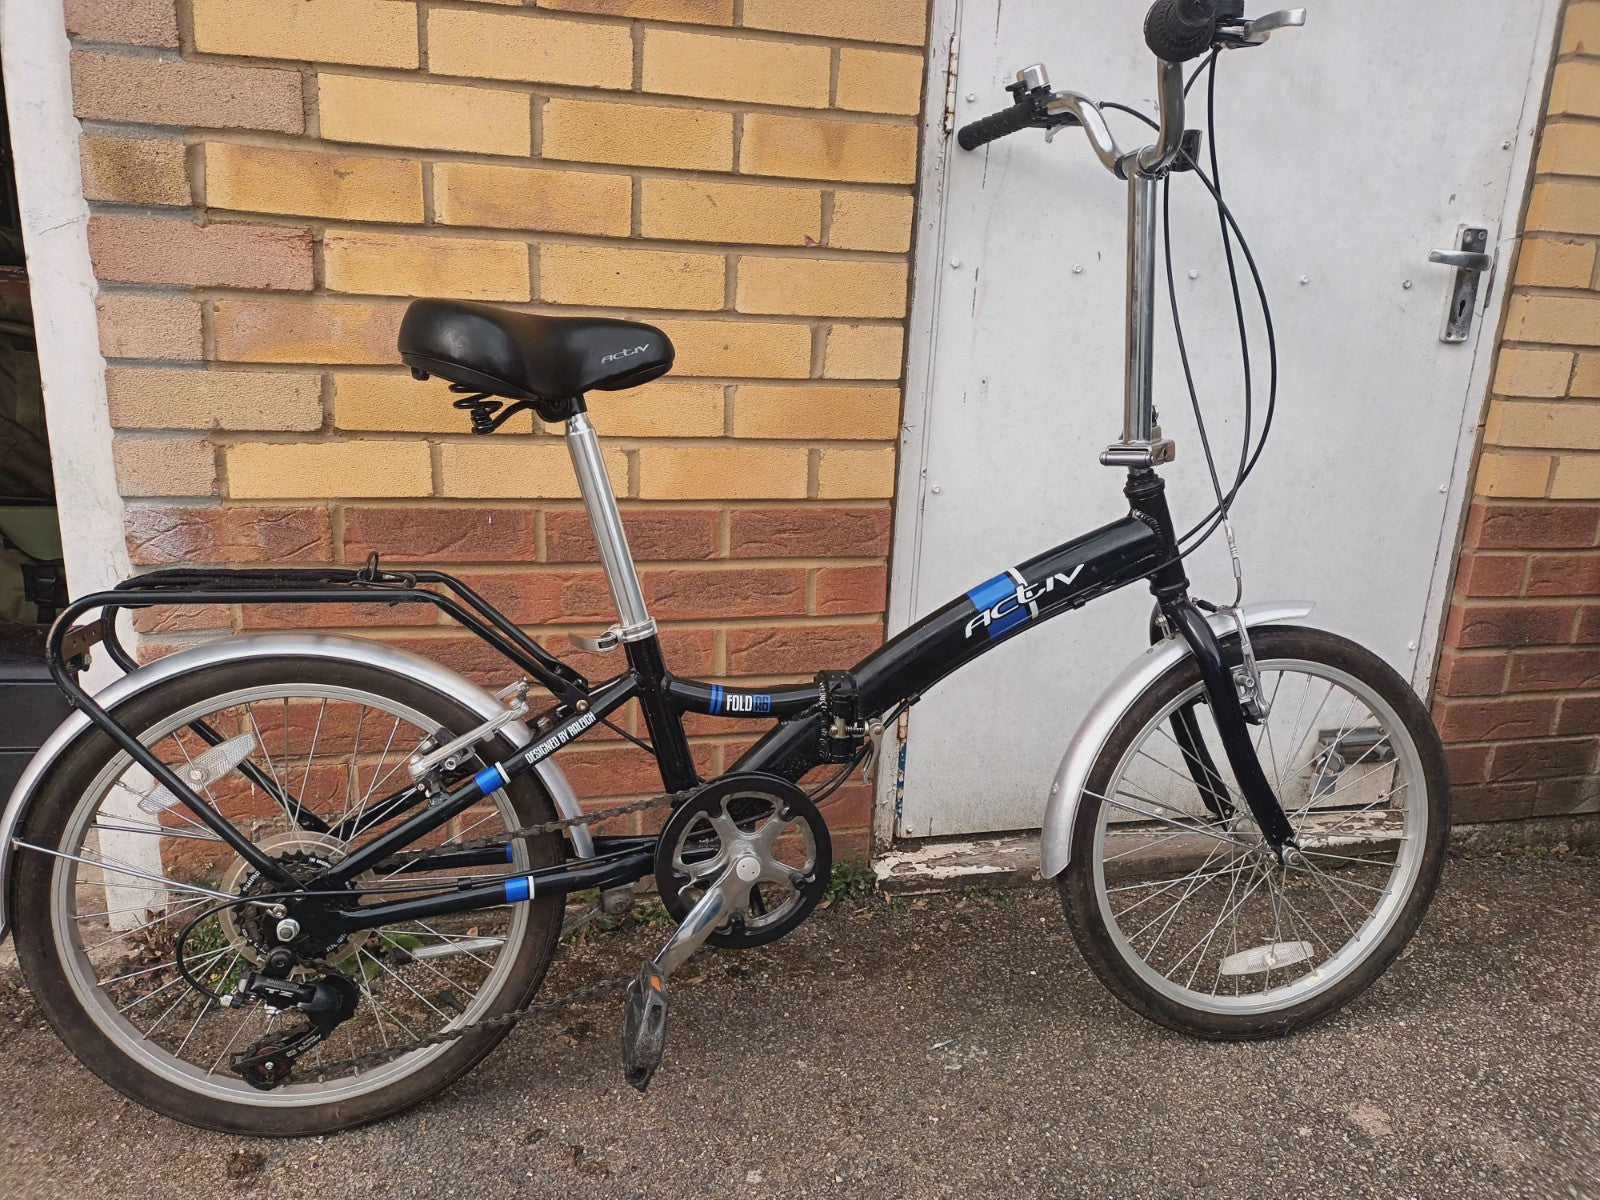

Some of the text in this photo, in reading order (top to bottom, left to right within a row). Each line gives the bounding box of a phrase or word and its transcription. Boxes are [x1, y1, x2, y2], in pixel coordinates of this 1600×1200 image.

[726, 694, 753, 712] FOLD
[524, 711, 597, 764] DESIGNED BY RALEIGH
